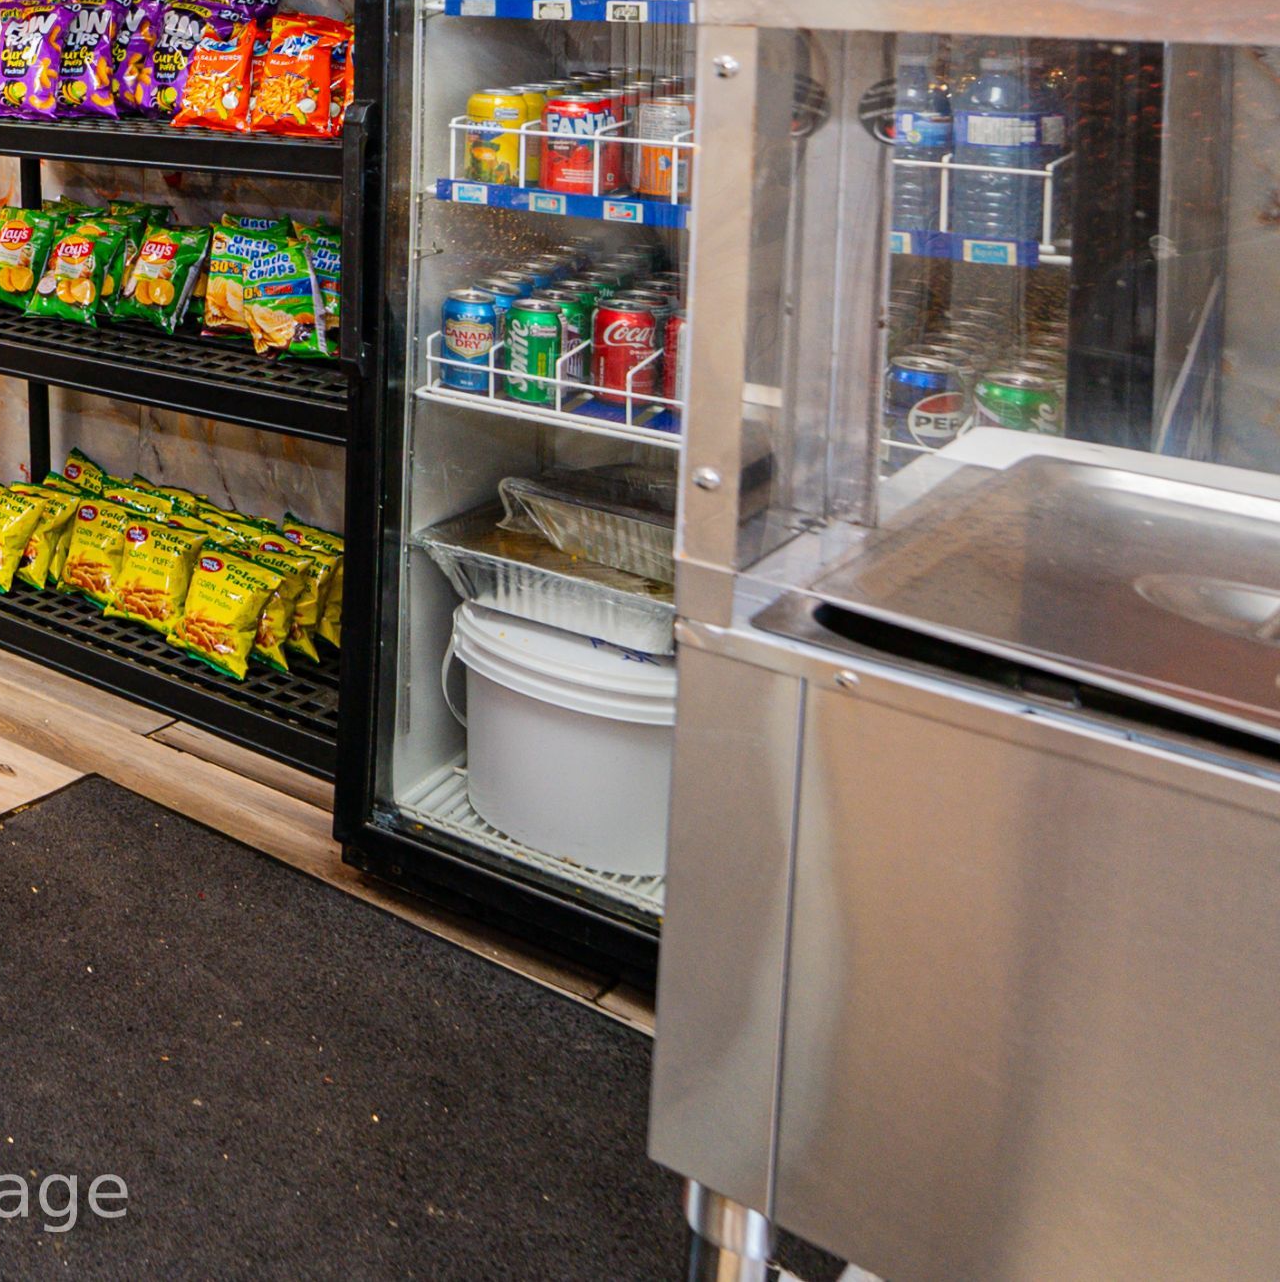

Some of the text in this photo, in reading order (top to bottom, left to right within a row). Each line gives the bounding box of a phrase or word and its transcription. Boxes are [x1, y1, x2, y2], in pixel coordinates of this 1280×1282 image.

[69, 9, 113, 35] UN
[67, 33, 100, 47] LIPS
[61, 46, 95, 64] urly
[0, 226, 29, 244] Lay's
[233, 235, 278, 252] Uncle
[57, 241, 90, 259] Lay's
[253, 252, 289, 269] Uncle
[248, 262, 296, 281] Chipps
[243, 286, 263, 300] 0%
[445, 327, 493, 342] CANADA
[455, 339, 481, 350] DRY
[507, 318, 530, 393] Sprite
[151, 528, 193, 551] Golden
[304, 534, 344, 556] Golde
[225, 573, 256, 594] Pack
[226, 562, 270, 591] Golden
